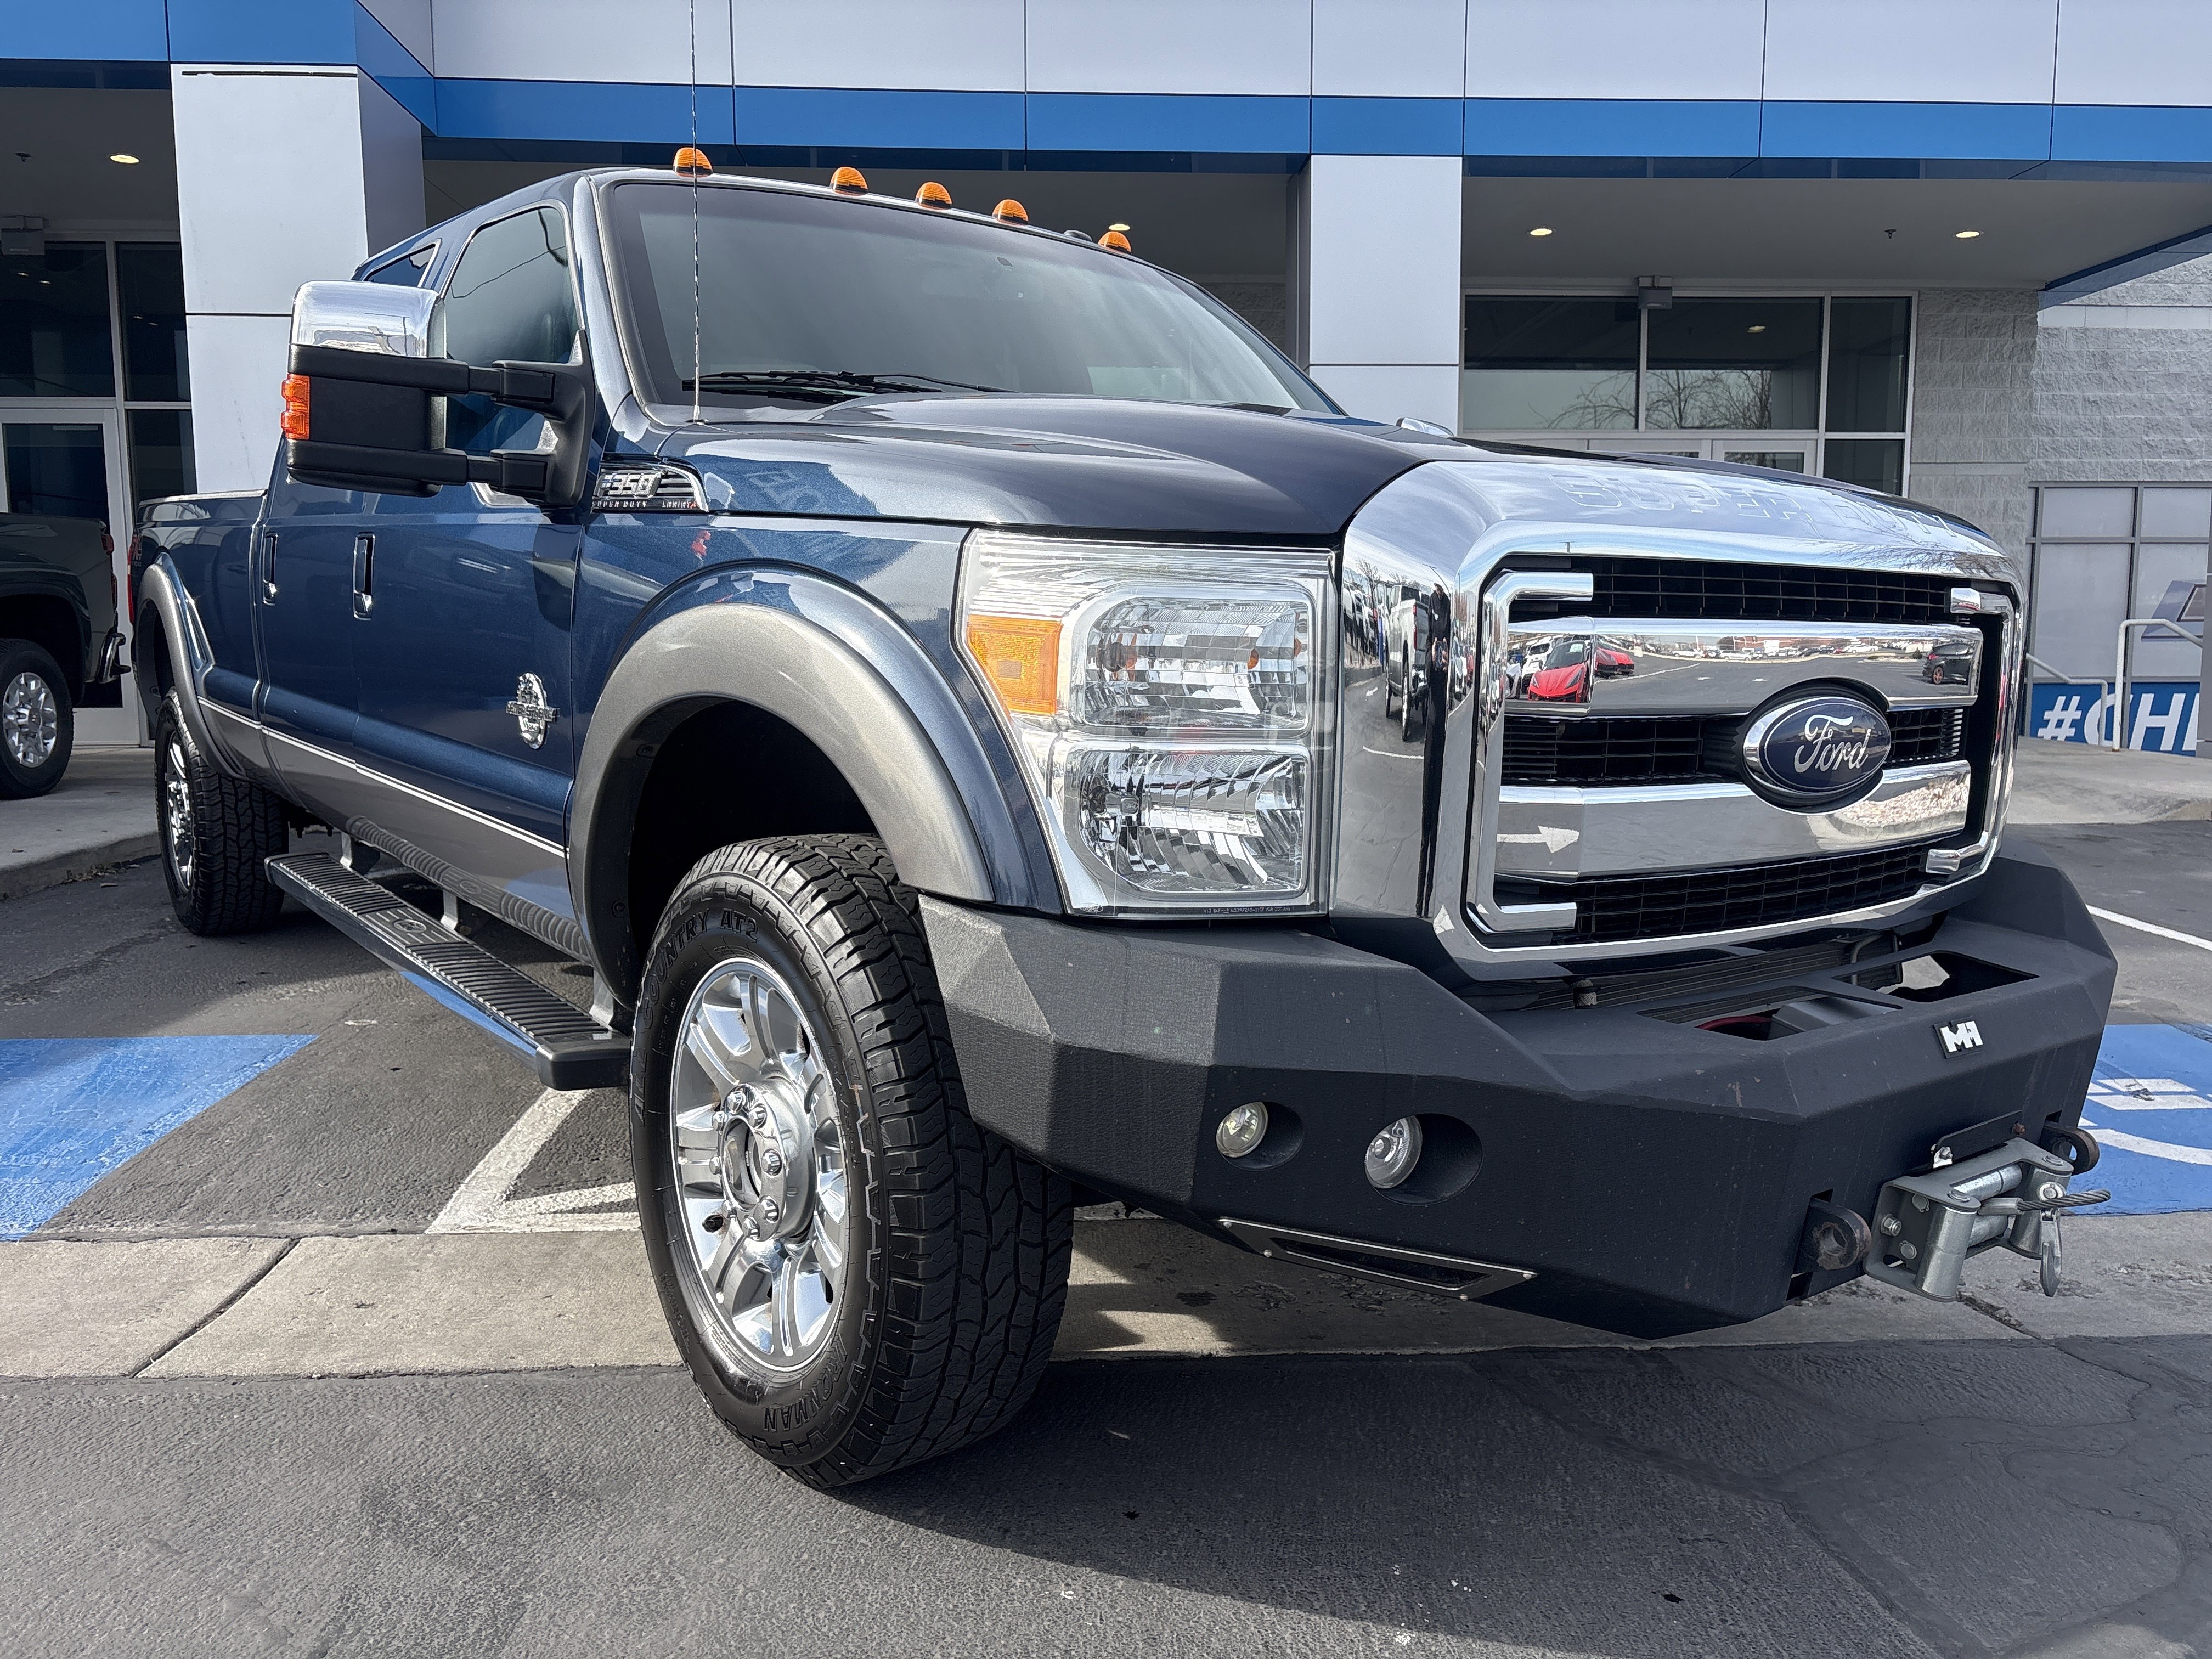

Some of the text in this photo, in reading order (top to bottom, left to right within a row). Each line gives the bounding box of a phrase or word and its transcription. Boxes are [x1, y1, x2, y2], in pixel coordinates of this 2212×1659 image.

[592, 500, 620, 508] SUPER
[623, 500, 647, 508] DUTY
[1549, 474, 1817, 528] SUPER
[1794, 714, 1871, 773] Ford
[2037, 692, 2200, 751] #CH
[720, 908, 758, 943] AT2
